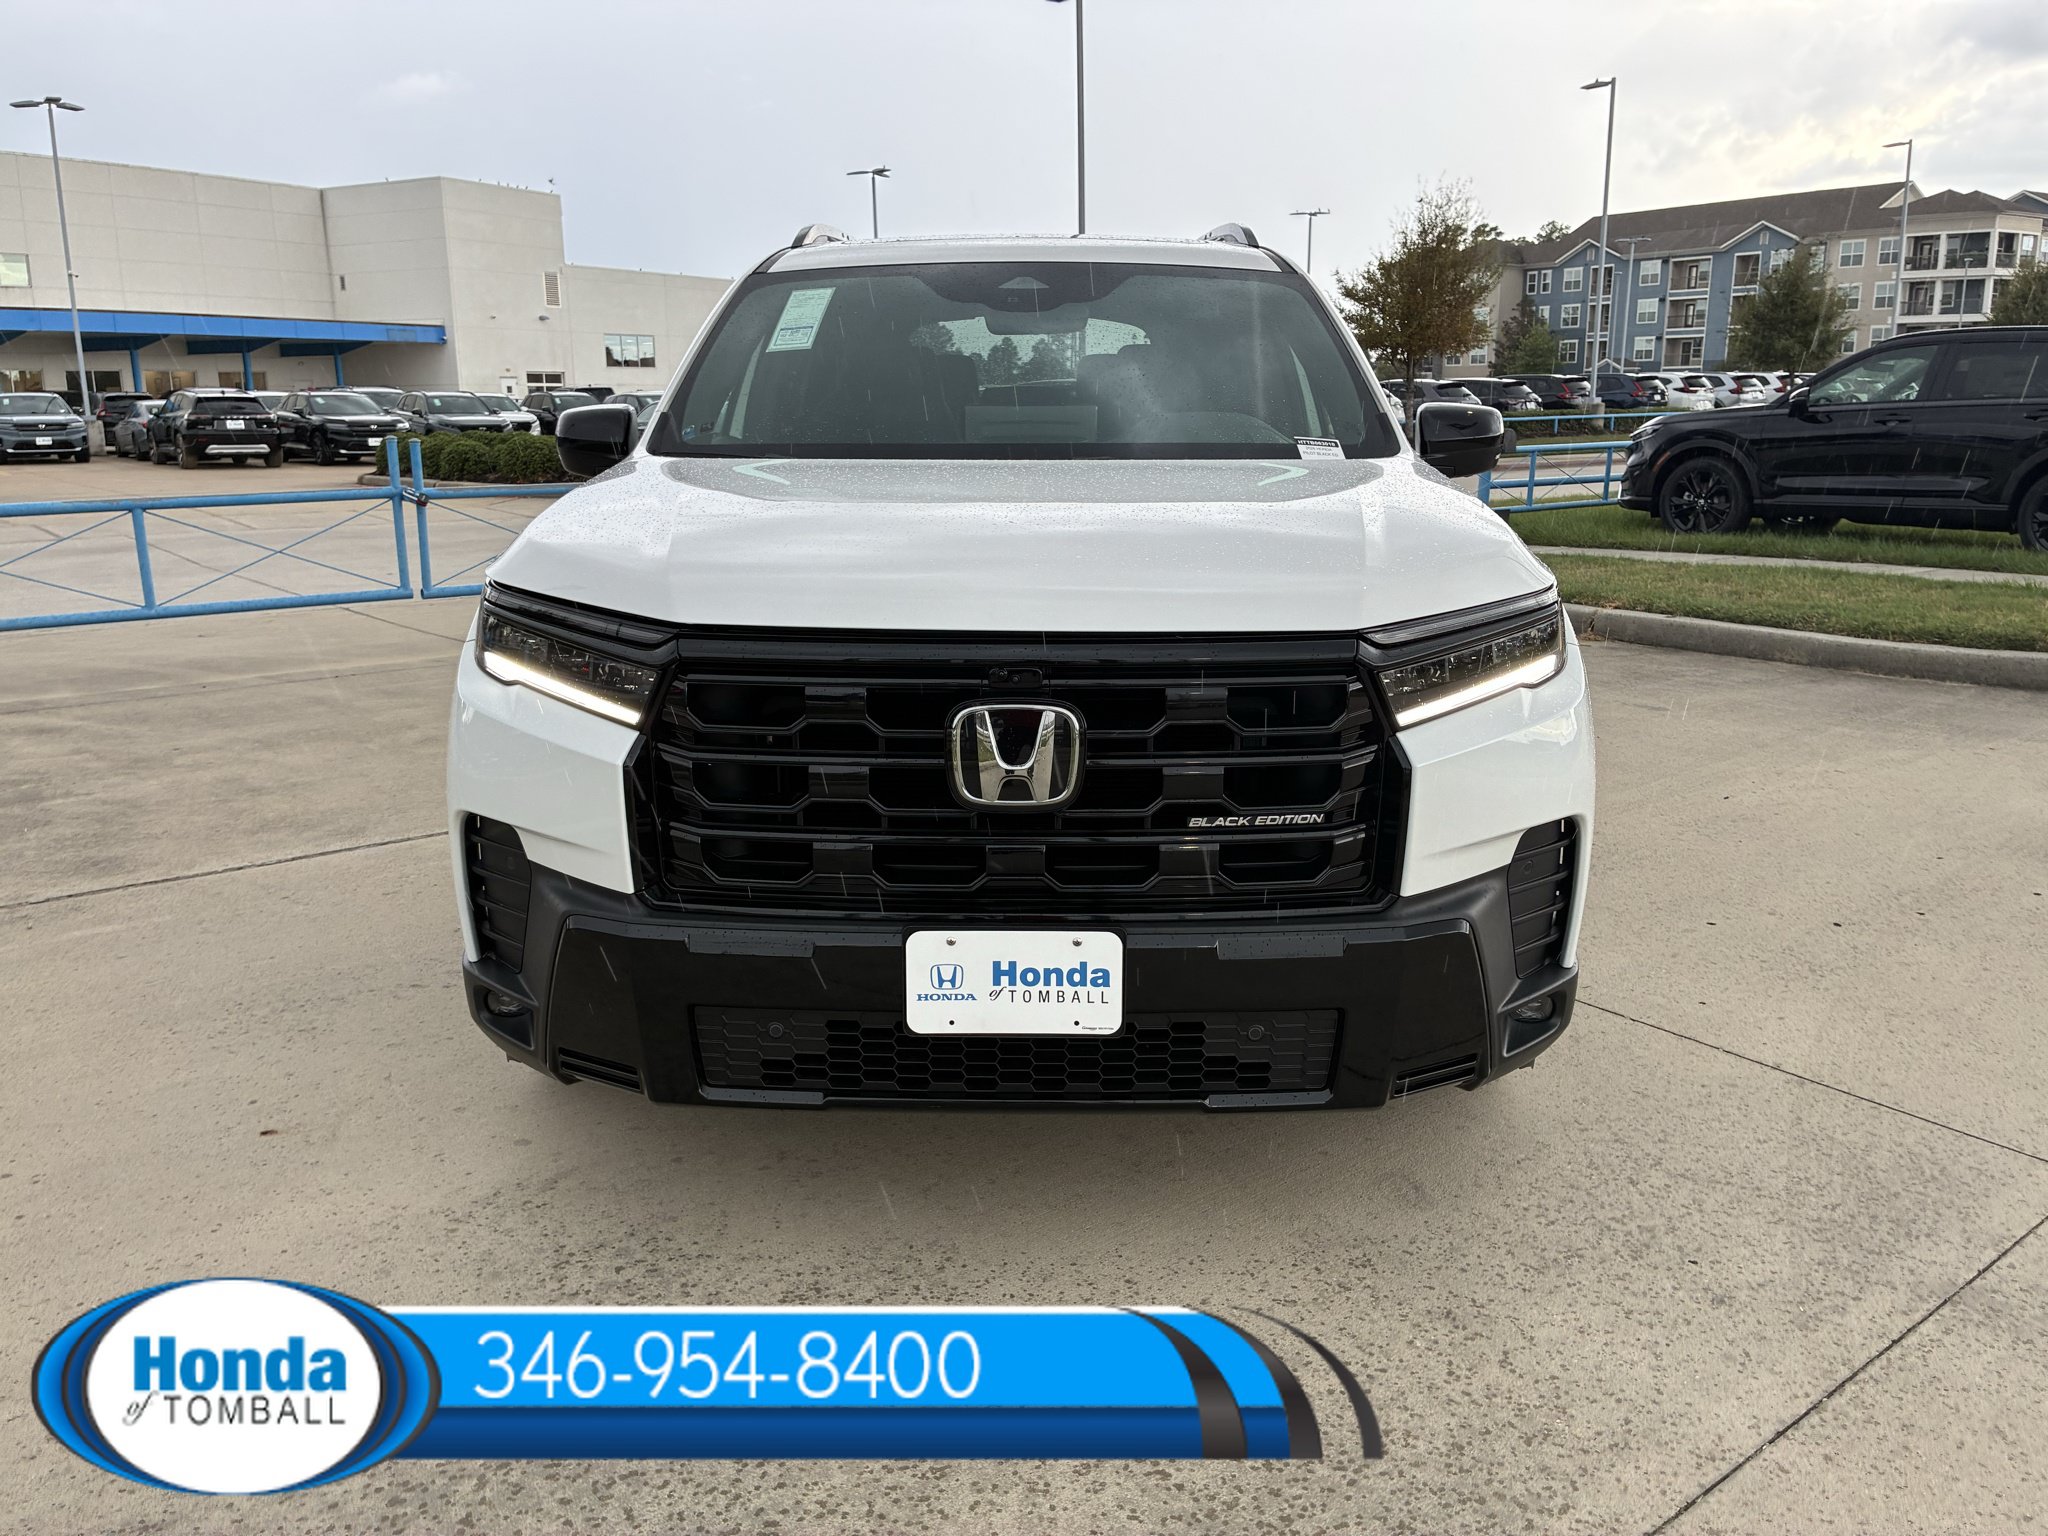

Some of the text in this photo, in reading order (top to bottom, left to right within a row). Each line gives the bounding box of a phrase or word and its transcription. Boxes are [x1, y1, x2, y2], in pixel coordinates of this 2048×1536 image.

[1188, 813, 1325, 827] BLACK EDITION
[992, 960, 1111, 988] Honda
[916, 993, 978, 1002] HONDA
[988, 986, 1109, 1004] of TOMBALL
